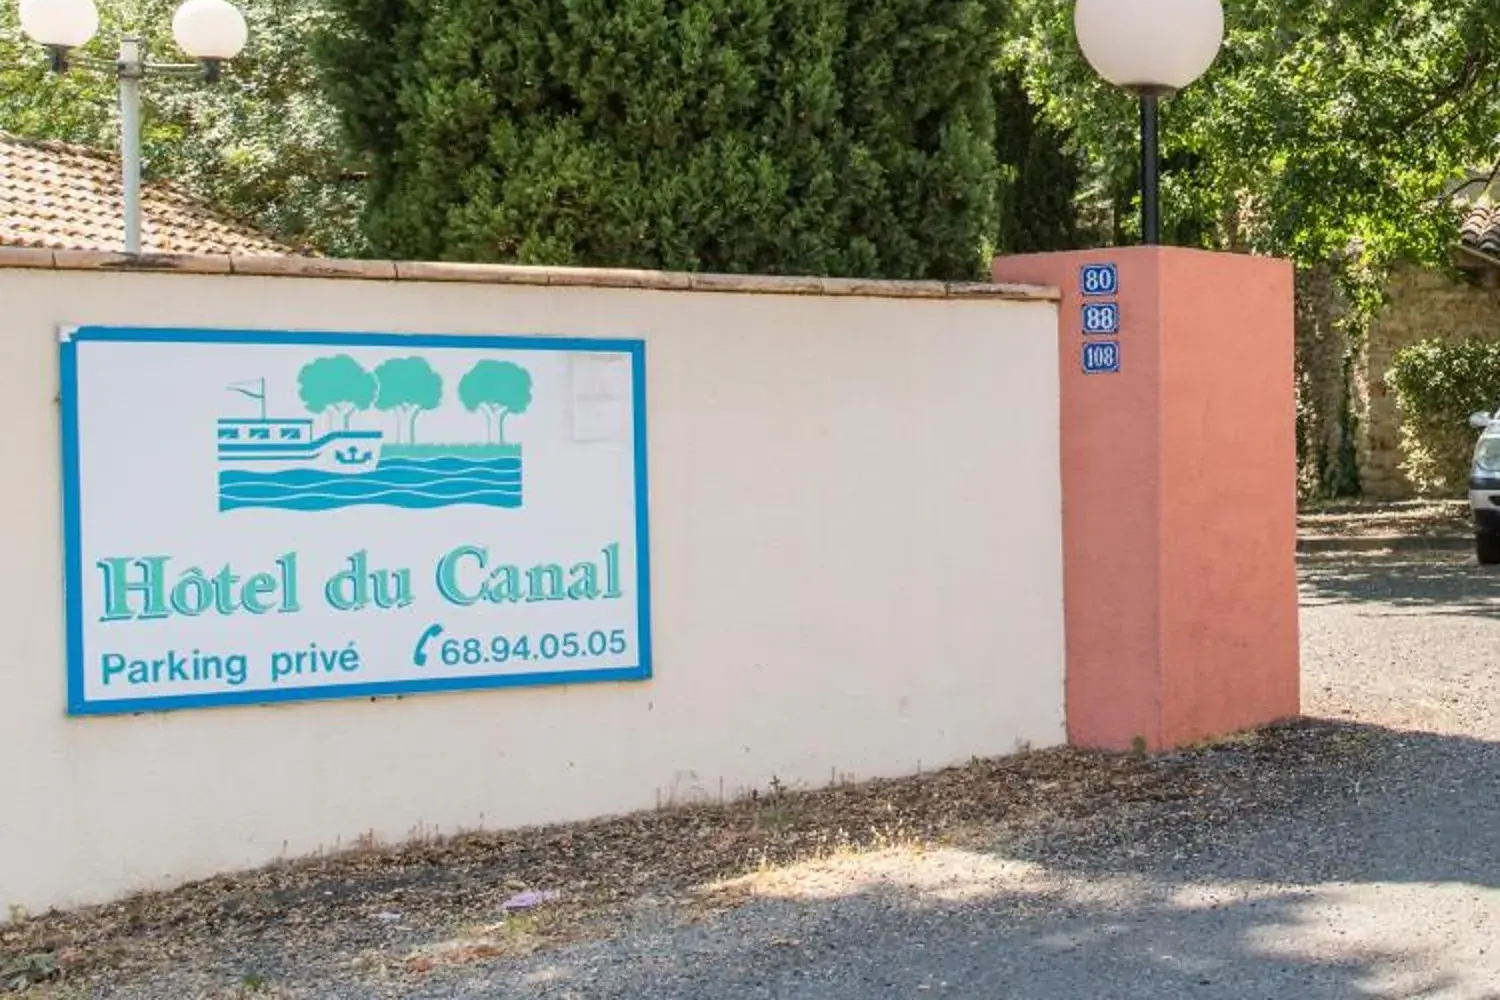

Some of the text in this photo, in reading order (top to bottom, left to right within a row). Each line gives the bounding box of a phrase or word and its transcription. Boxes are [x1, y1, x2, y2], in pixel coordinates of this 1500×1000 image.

[1085, 269, 1112, 291] 80
[1086, 307, 1113, 329] 88
[1086, 346, 1114, 368] 108
[96, 542, 623, 622] Hôtel du Canal
[440, 629, 627, 666] 68.94.05.05
[101, 641, 360, 685] Parking privé
